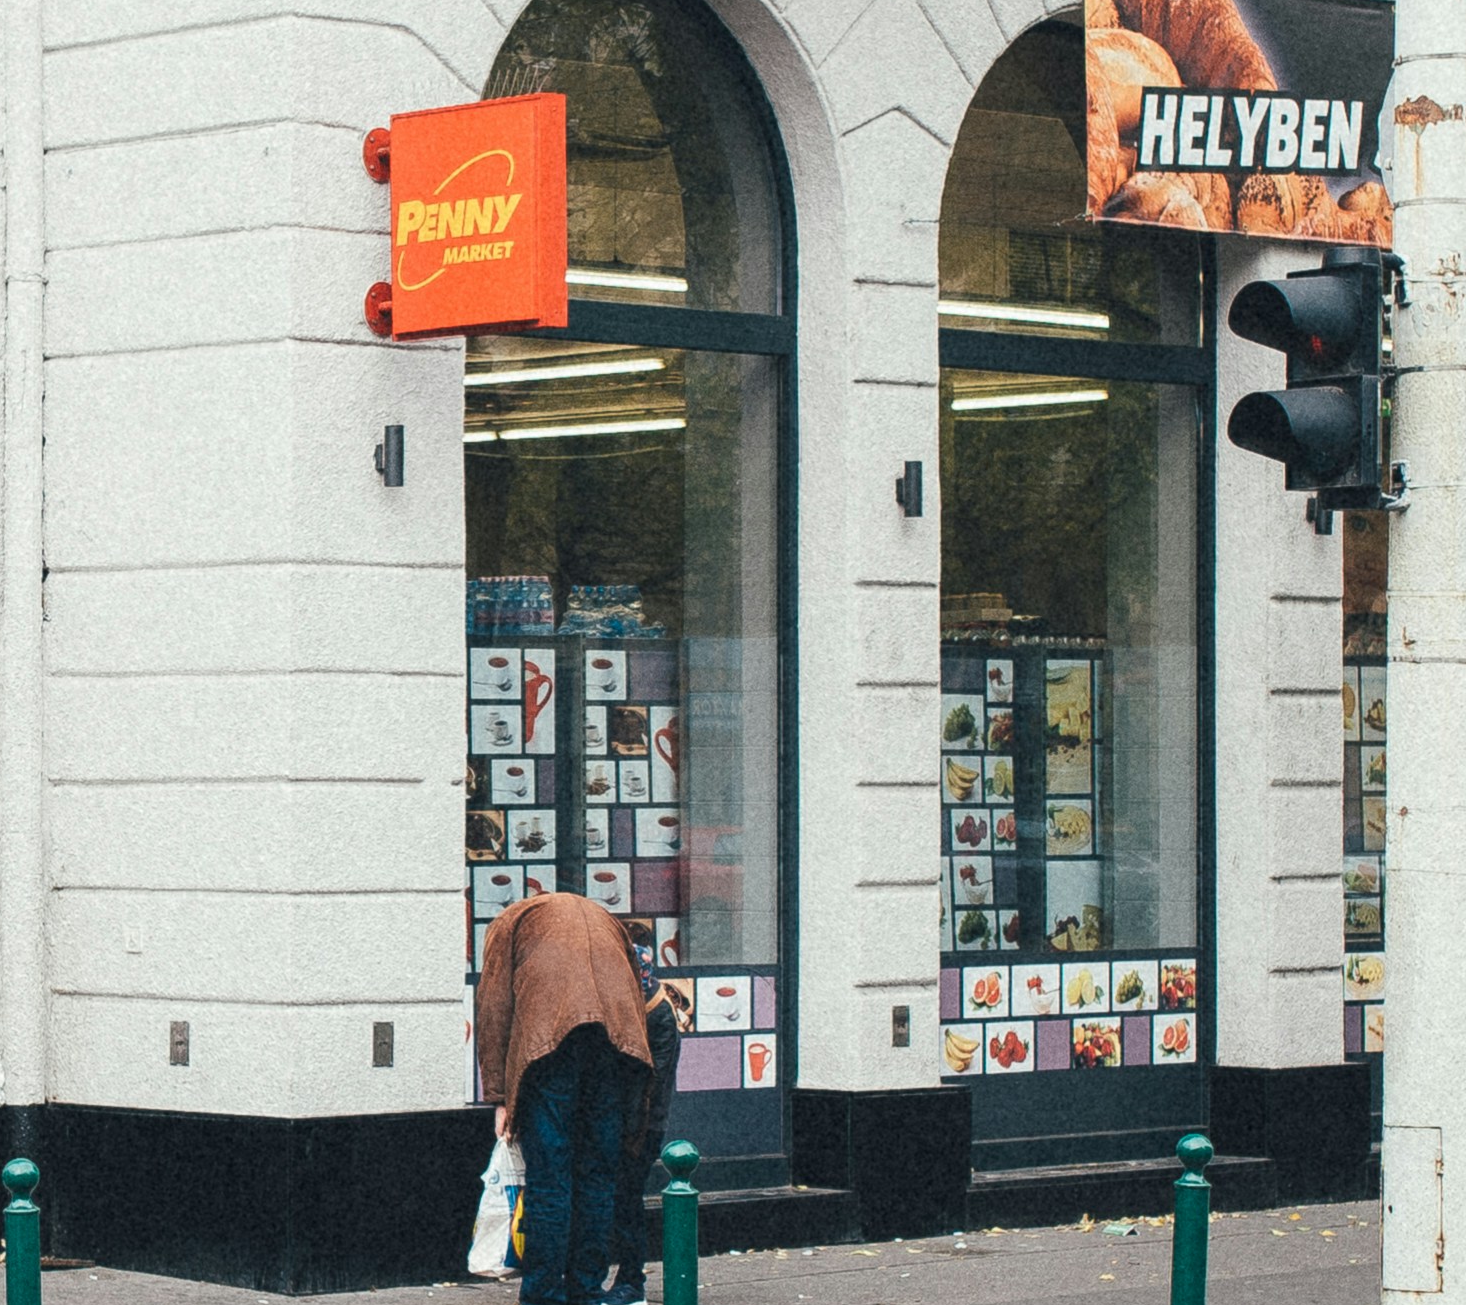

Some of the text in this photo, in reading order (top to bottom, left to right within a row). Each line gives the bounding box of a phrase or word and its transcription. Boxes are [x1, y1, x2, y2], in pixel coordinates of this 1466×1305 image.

[1140, 94, 1363, 170] HELYBEN
[396, 193, 524, 247] PENNY
[442, 241, 515, 266] MARKET
